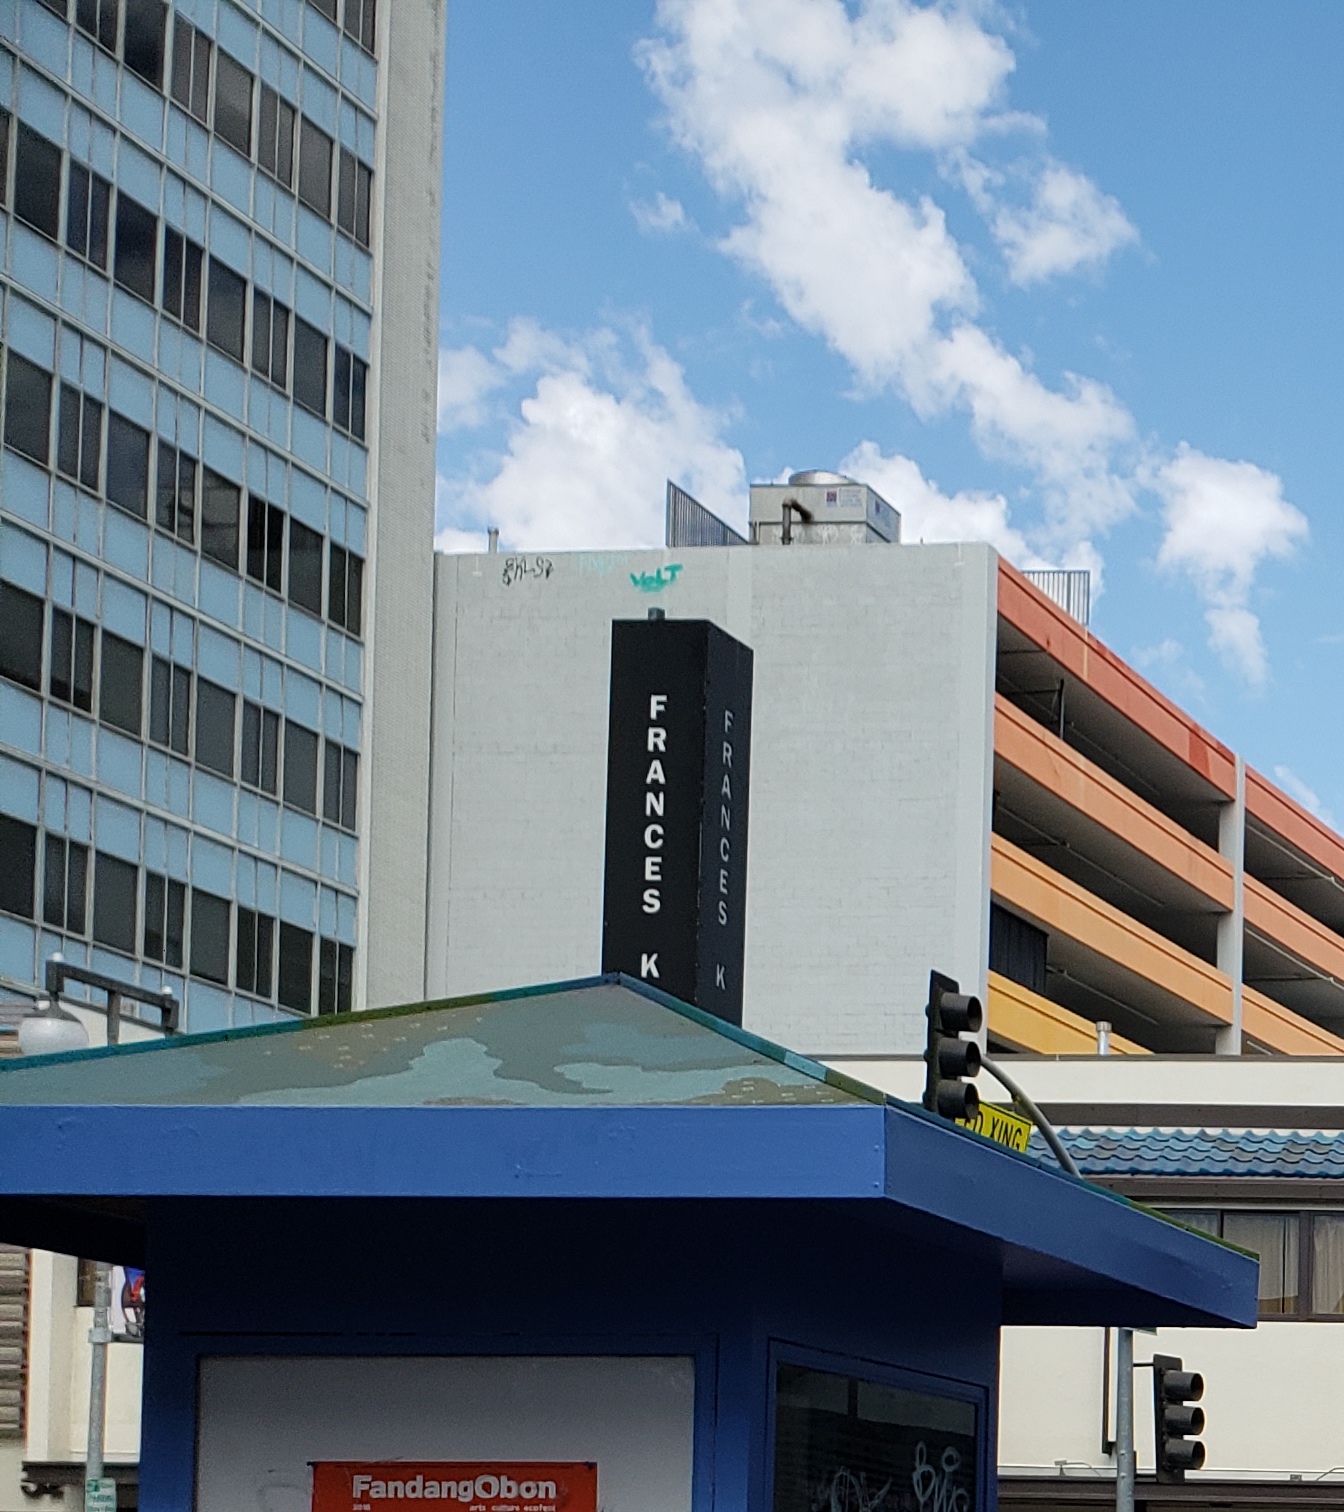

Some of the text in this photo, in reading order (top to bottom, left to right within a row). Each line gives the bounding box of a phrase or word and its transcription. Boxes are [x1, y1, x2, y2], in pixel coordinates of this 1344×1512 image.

[640, 694, 668, 979] FRANCES K
[714, 709, 735, 991] FRANCES K
[989, 1116, 1023, 1151] XING
[352, 1473, 557, 1502] FandangObon
